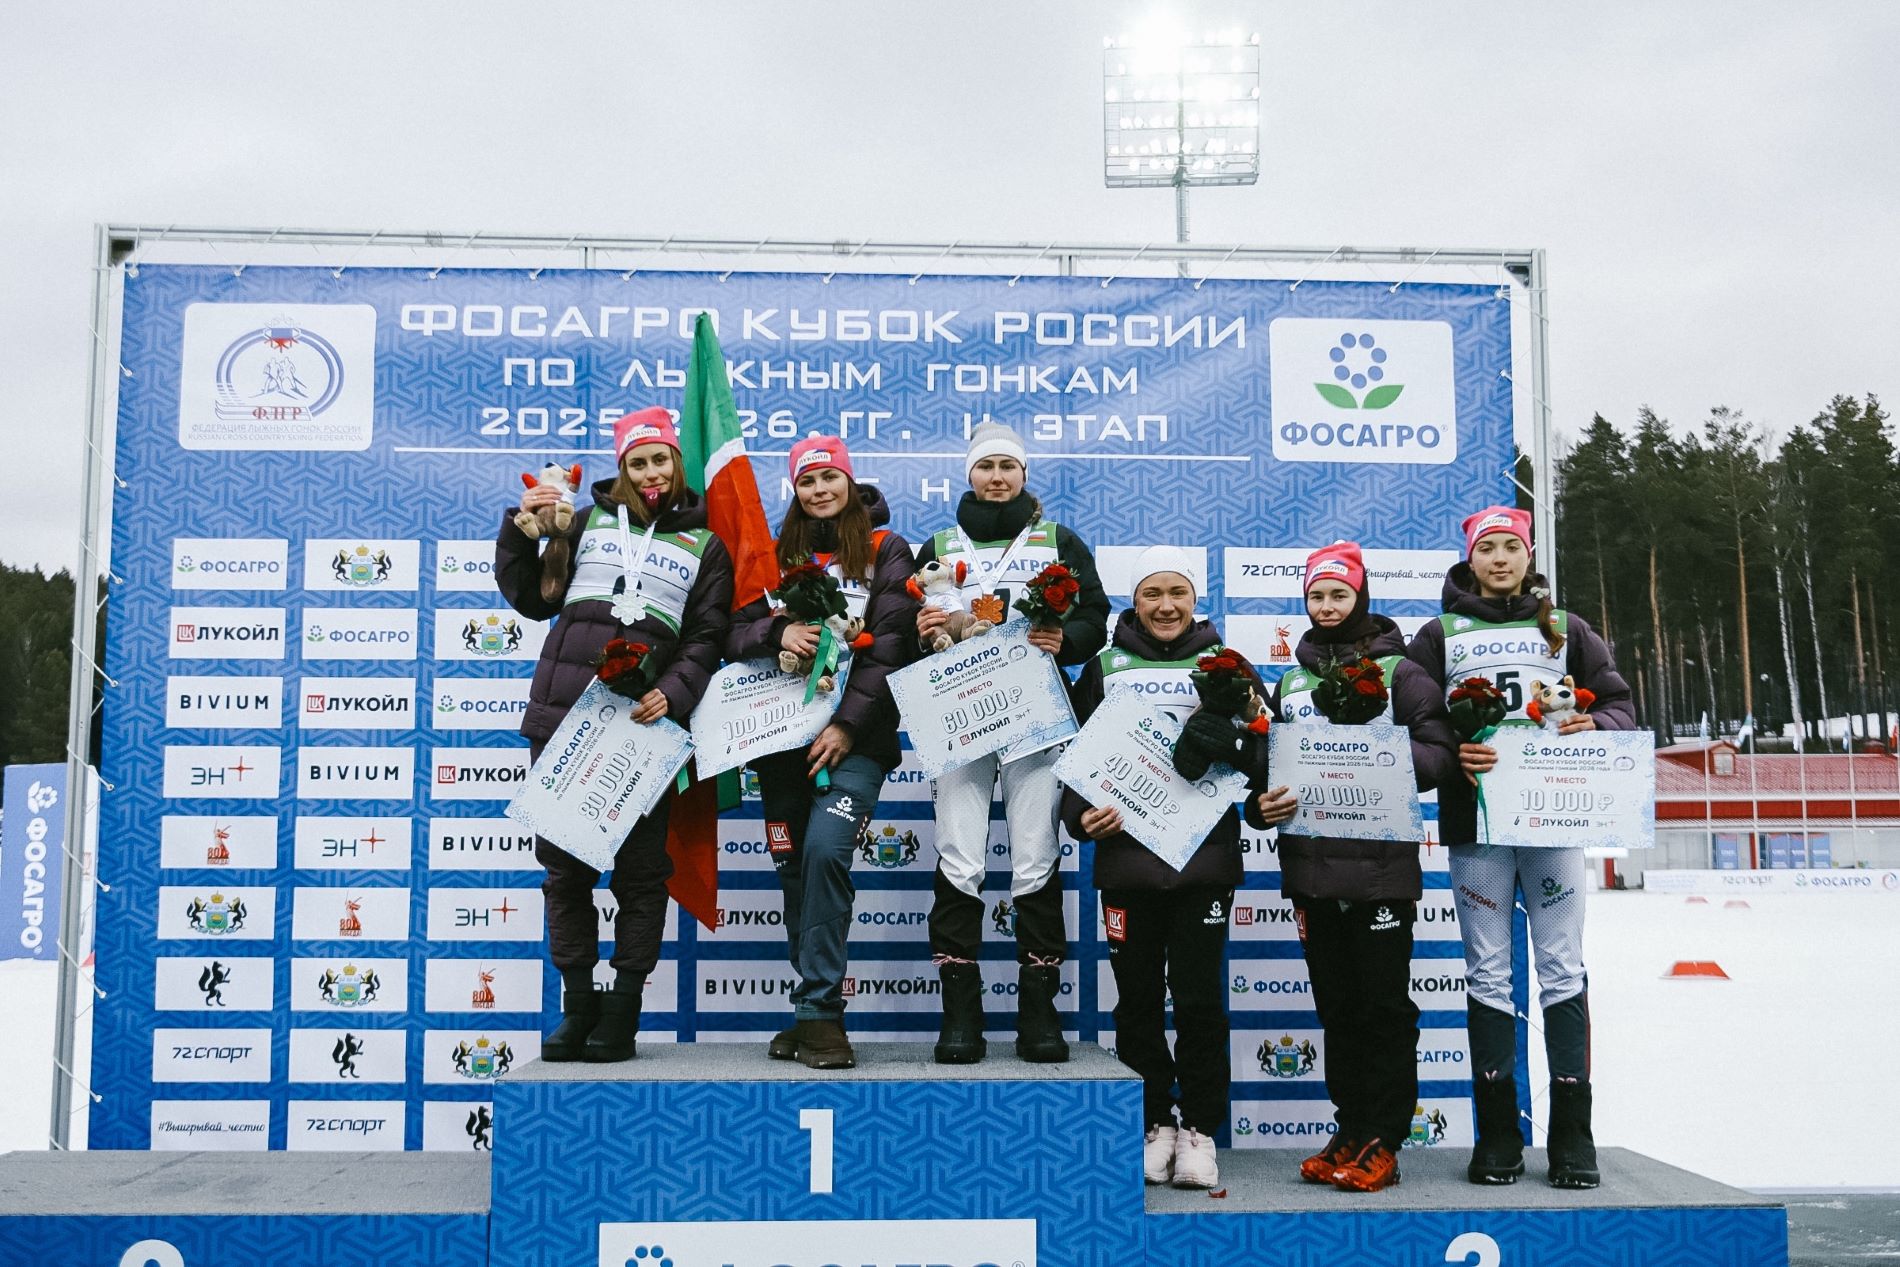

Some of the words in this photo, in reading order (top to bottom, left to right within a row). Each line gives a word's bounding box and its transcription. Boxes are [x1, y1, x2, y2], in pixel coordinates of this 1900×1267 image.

[401, 304, 720, 339] ФОСАГРО
[743, 308, 962, 343] КУБОК
[994, 311, 1246, 349] РОССИИ
[504, 357, 575, 387] ПО
[927, 363, 1137, 394] ГОНКАМ
[192, 424, 246, 433] ФЕДЕРАЦИЯ
[248, 425, 289, 433] ЛЫЖНЫХ
[291, 425, 320, 433] ГОНОК
[1033, 414, 1168, 442] ЭТАП
[1280, 422, 1440, 448] ФОСАГРО
[199, 560, 280, 573] ФОСАГРО
[601, 541, 690, 581] ФАГРО
[197, 624, 279, 641] ЛУКОЙЛ
[329, 630, 410, 643] ФОСАГРО
[944, 646, 1000, 676] ФОСАГРО
[737, 669, 783, 686] ФОСАГ
[934, 675, 960, 691] ФОСАГРО
[961, 668, 979, 679] КУБОК
[980, 657, 1003, 670] РОССИИ
[982, 666, 996, 676] 2026
[957, 691, 966, 700] III
[967, 680, 993, 696] МЕСТО
[180, 694, 269, 709] BIVIUM
[326, 694, 408, 711] ЛУКОЙЛ
[460, 700, 529, 713] ФОСАГР
[754, 695, 780, 709] МЕСТО
[941, 707, 969, 734] 60
[969, 688, 1008, 722] 000
[722, 714, 757, 741] 100
[761, 701, 796, 727] 000
[970, 716, 1011, 741] ЛУКОЙЛ
[748, 725, 788, 745] ЛУКОЙЛ
[553, 720, 592, 775] ФОСАГРО
[1134, 729, 1159, 750] ФОСАГРО
[1157, 747, 1172, 760] КУБО
[1313, 742, 1369, 753] ФОСАГРО
[1540, 747, 1607, 758] ФОСАГРО
[310, 765, 399, 781] BIVIUM
[457, 765, 527, 782] ЛУКОЙ
[585, 752, 604, 779] МЕСТО
[1137, 754, 1148, 763] IV
[1146, 761, 1171, 783] МЕСТО
[554, 767, 573, 793] ФОСАГРО
[1104, 752, 1132, 780] 40
[1128, 771, 1168, 808] 000
[1319, 771, 1326, 779] V
[1327, 772, 1354, 780] МЕСТО
[1556, 777, 1587, 785] МЕСТО
[578, 791, 607, 821] 80
[595, 752, 631, 794] 000
[614, 770, 643, 812] ЛУКОЙЛ
[1299, 783, 1325, 805] 20
[1328, 784, 1367, 807] 000
[1109, 787, 1148, 819] ЛУКОЙЛ
[1519, 788, 1545, 811] 10
[1550, 789, 1593, 812] 000
[1325, 811, 1366, 821] ЛУКОЙЛ
[1541, 817, 1589, 828] ЛУКОЙЛ
[443, 836, 533, 851] BIVIUM
[20, 817, 48, 948] ФОСАГРО
[1811, 876, 1872, 887] ФОСАГРО
[1541, 887, 1575, 909] ФОСАГРО
[726, 910, 785, 926] ЛУКО
[857, 912, 931, 926] ФОСАГР
[705, 979, 795, 995] BIVIUM
[857, 976, 941, 994] ЛУКОЙЛ
[1253, 979, 1313, 994] ФОСАГ
[1411, 976, 1465, 992] КОЙЛ
[1257, 1121, 1339, 1136] ФОСАГРО
[799, 1109, 834, 1194] 1
